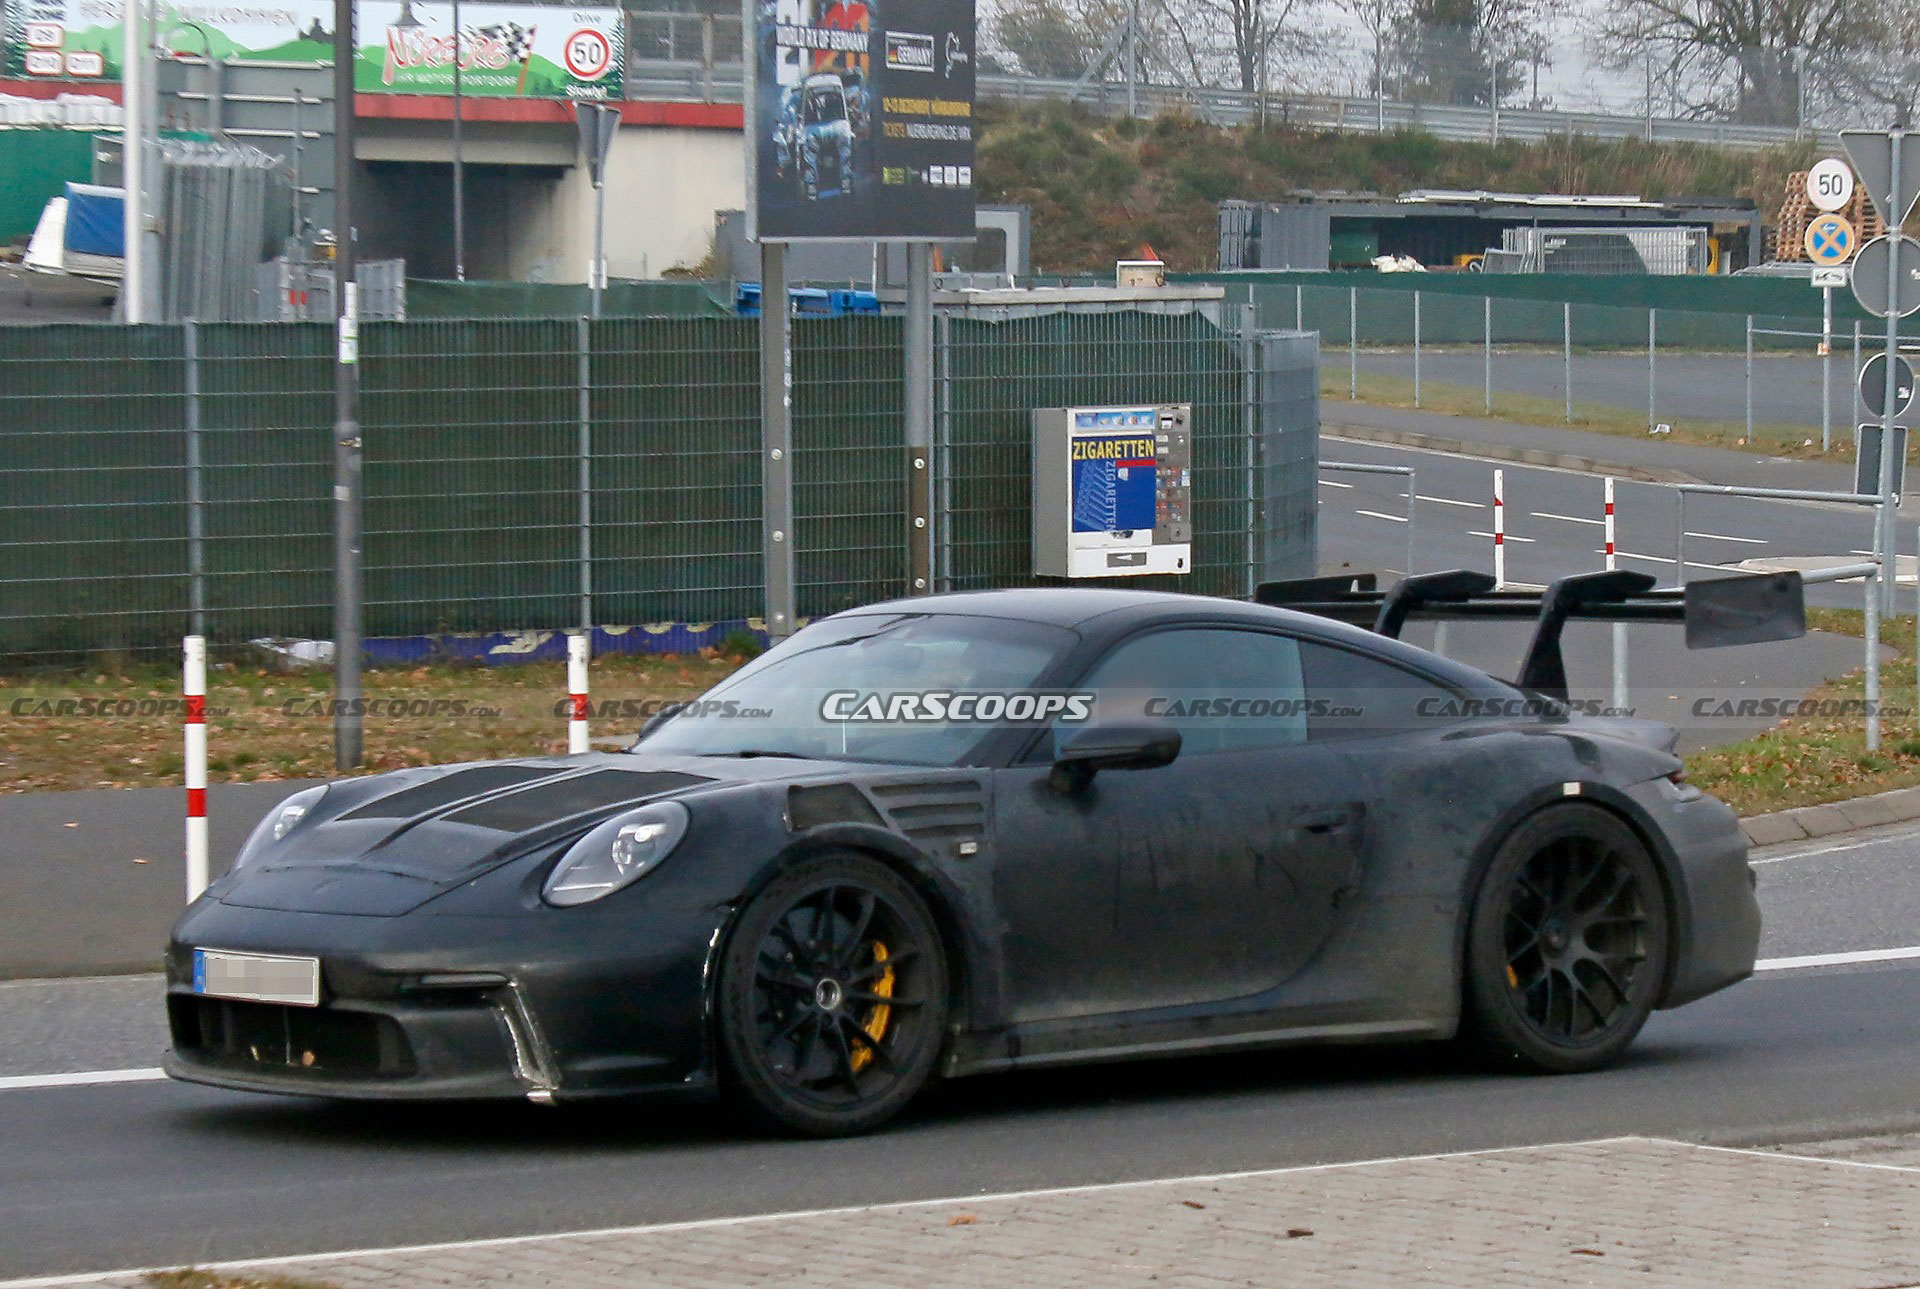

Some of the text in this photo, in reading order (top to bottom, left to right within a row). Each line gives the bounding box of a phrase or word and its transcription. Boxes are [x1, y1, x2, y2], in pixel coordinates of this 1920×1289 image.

[573, 12, 600, 23] Drive
[573, 42, 600, 65] 50
[1819, 173, 1843, 196] 50
[1072, 439, 1155, 461] ZIGARETTEN
